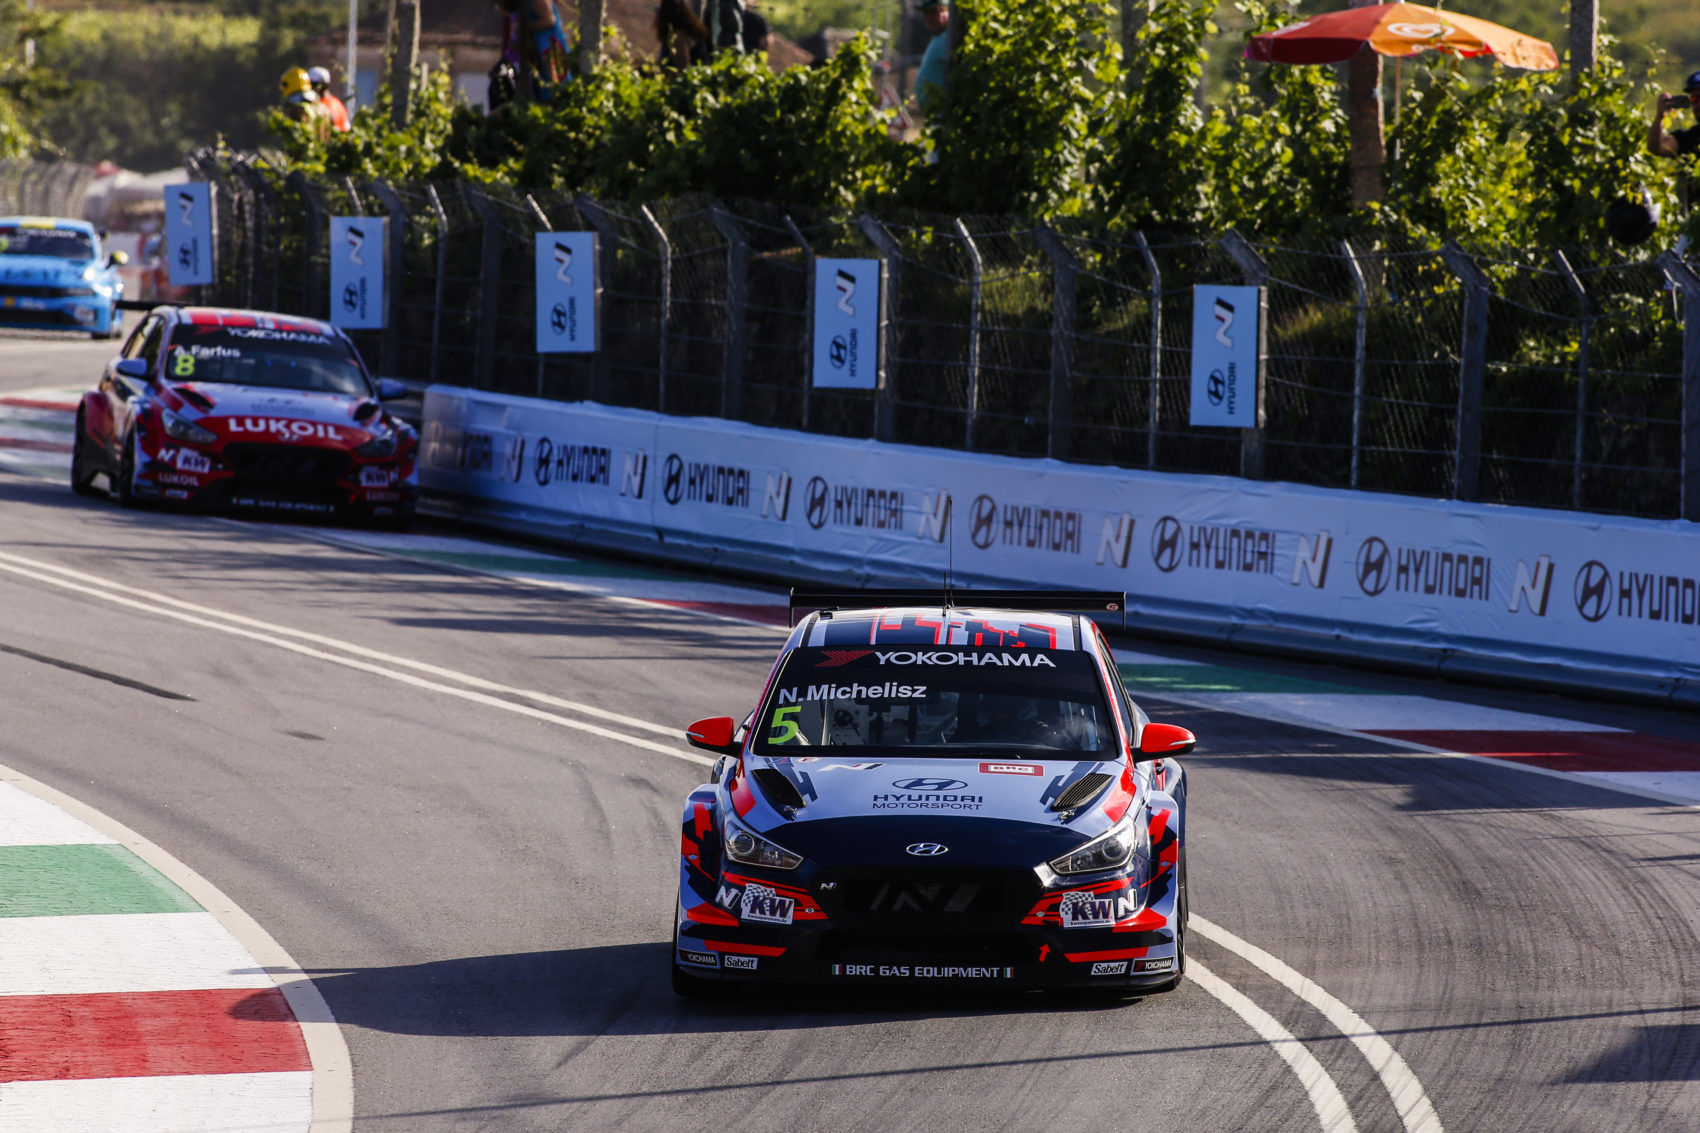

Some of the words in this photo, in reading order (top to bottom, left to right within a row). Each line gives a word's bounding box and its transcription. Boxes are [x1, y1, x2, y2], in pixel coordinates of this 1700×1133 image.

[226, 326, 332, 344] YOKOHAMA
[175, 355, 195, 376] 8
[1227, 362, 1236, 415] HYUNDAI
[228, 418, 343, 440] LUKOIL
[159, 473, 199, 487] LUKOIL
[554, 443, 611, 486] HYUNDAI
[687, 461, 750, 508] HYUNDAI
[833, 484, 904, 531] HYUNDAI
[1002, 504, 1083, 555] HYUNDAI
[1188, 524, 1276, 575] HYUNDAI
[1396, 547, 1491, 602] HYUNDAI
[1618, 570, 1700, 626] HYUND
[875, 651, 1056, 668] YOKOHAMA
[767, 705, 802, 745] 5
[872, 803, 983, 811] MOTORSPORT
[873, 794, 983, 803] HYUNDAI
[750, 895, 793, 919] KW
[1072, 900, 1112, 921] KW
[688, 954, 716, 964] YOKOHAMA
[726, 956, 756, 969] Sabelt
[1144, 959, 1173, 970] YOKOHAMA
[846, 964, 875, 976] BRC
[879, 965, 910, 977] GAS
[914, 966, 1000, 979] EQUIPMENT
[1093, 963, 1124, 975] Sabelt
